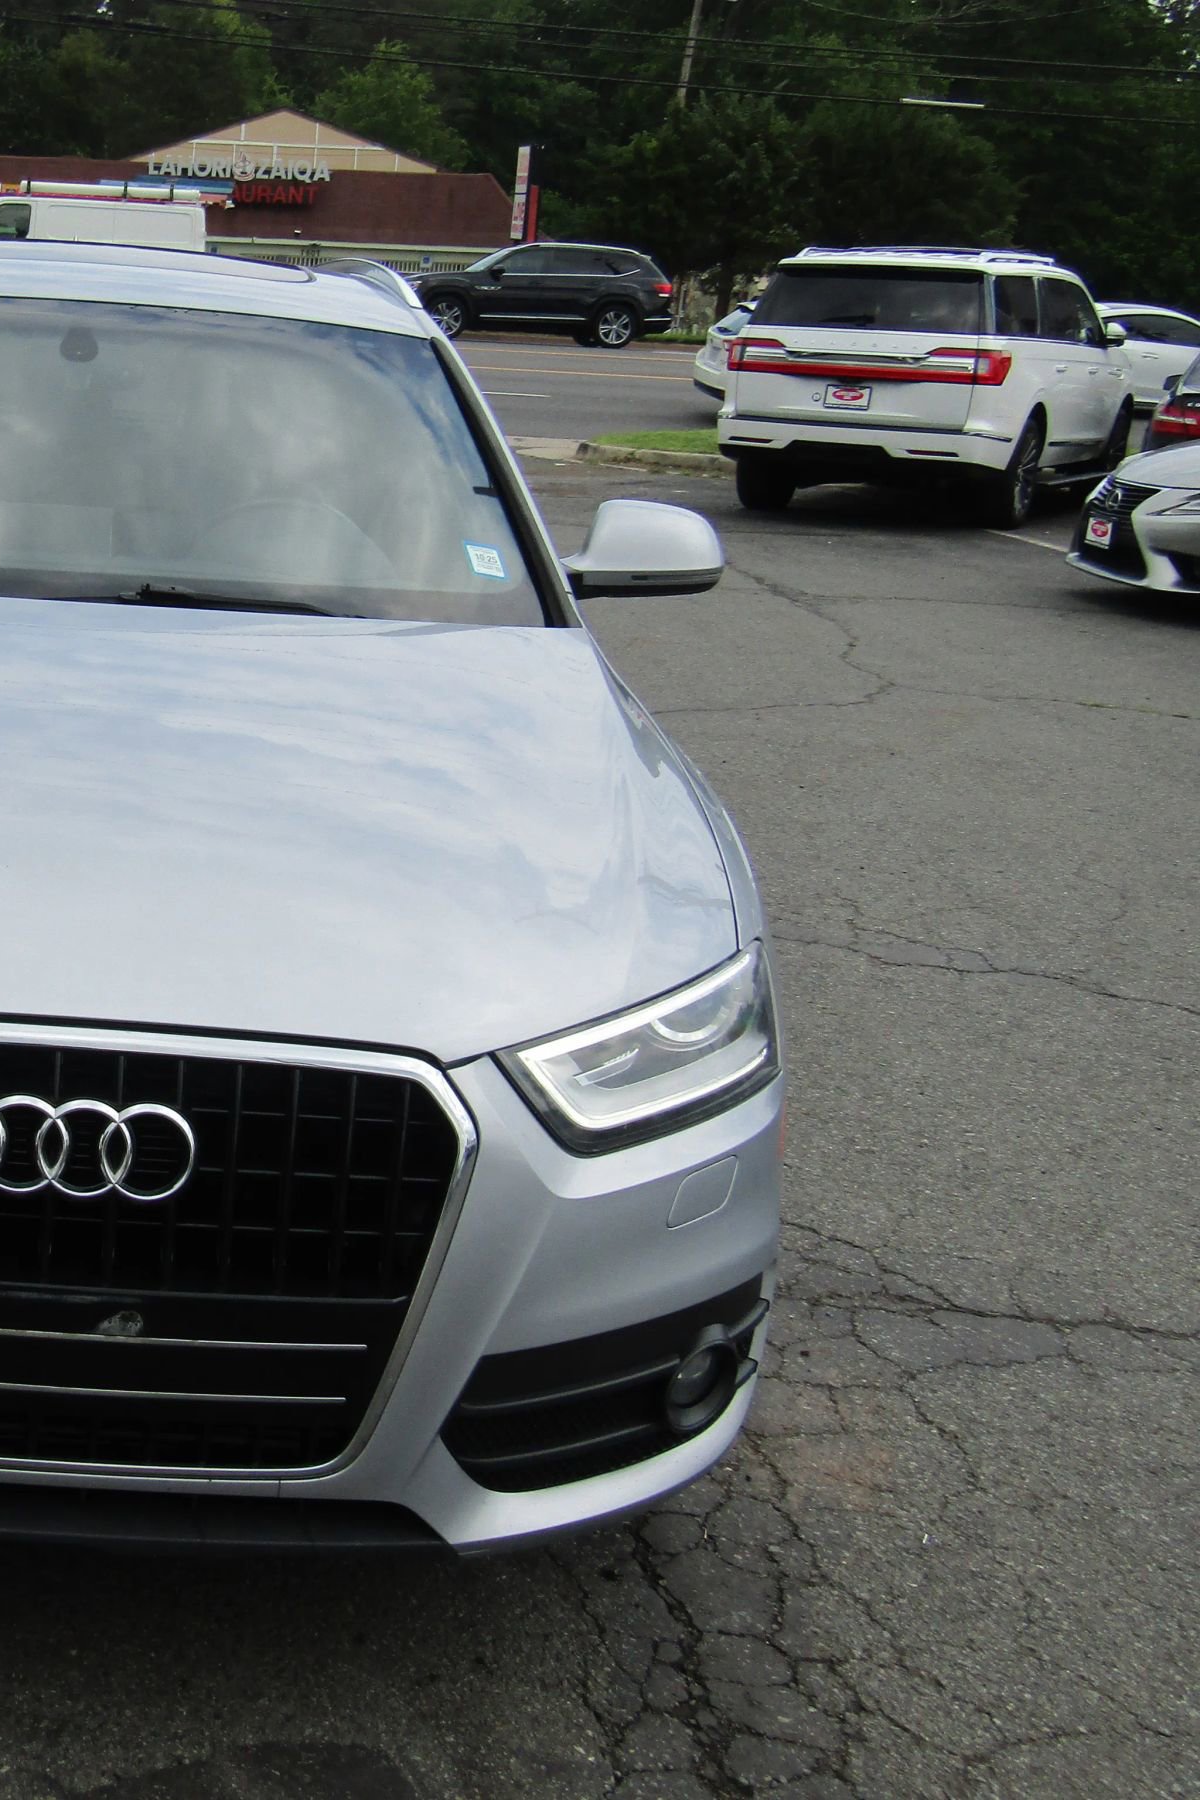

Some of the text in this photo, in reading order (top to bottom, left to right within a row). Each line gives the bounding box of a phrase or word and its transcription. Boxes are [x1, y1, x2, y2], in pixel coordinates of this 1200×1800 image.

[147, 156, 331, 183] LAHORI ZAIQA
[233, 183, 321, 206] AURANT
